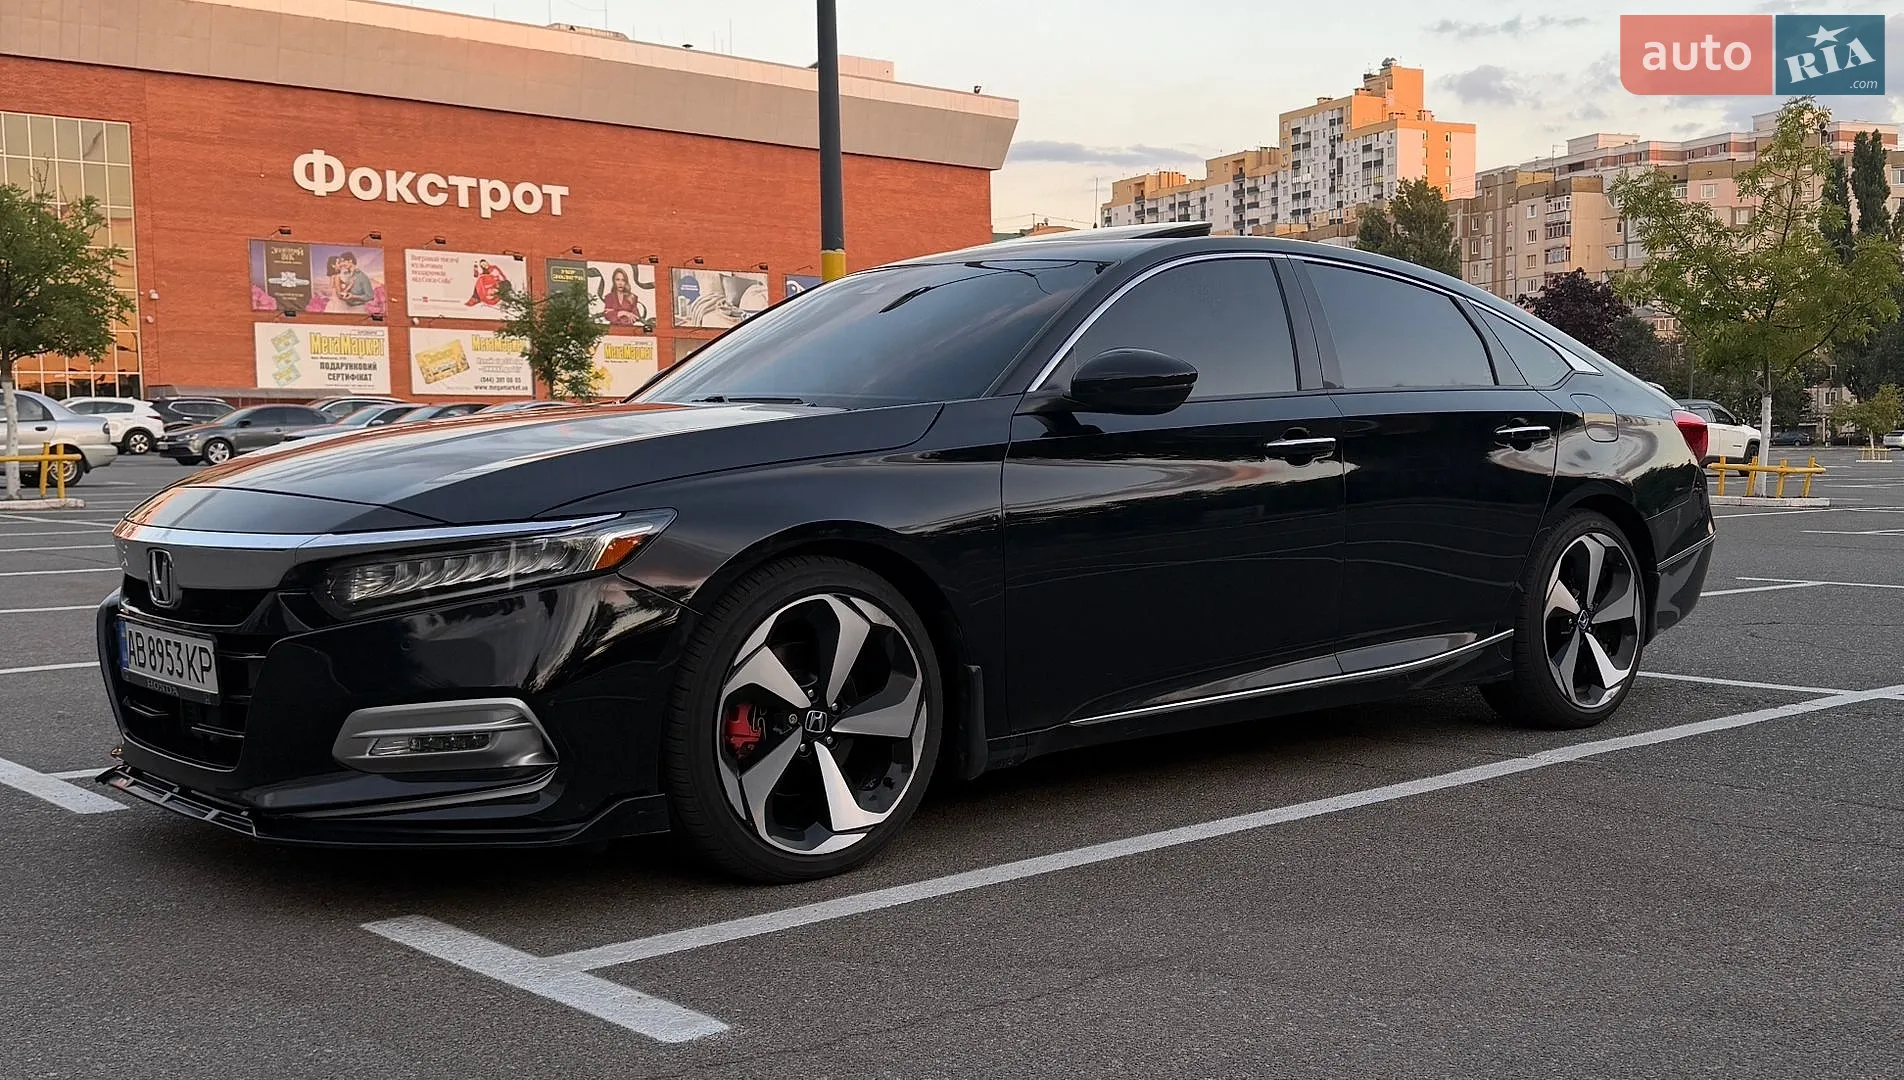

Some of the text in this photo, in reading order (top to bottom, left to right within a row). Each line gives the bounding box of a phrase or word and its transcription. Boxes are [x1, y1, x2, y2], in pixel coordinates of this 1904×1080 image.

[293, 149, 569, 218] Фокстрот
[309, 332, 384, 359] МегаМаркет
[320, 360, 377, 371] ПОДАРУНКОВИЙ
[327, 372, 372, 382] СЕРТИФІКАТ
[127, 630, 212, 684] AB 8953 KP
